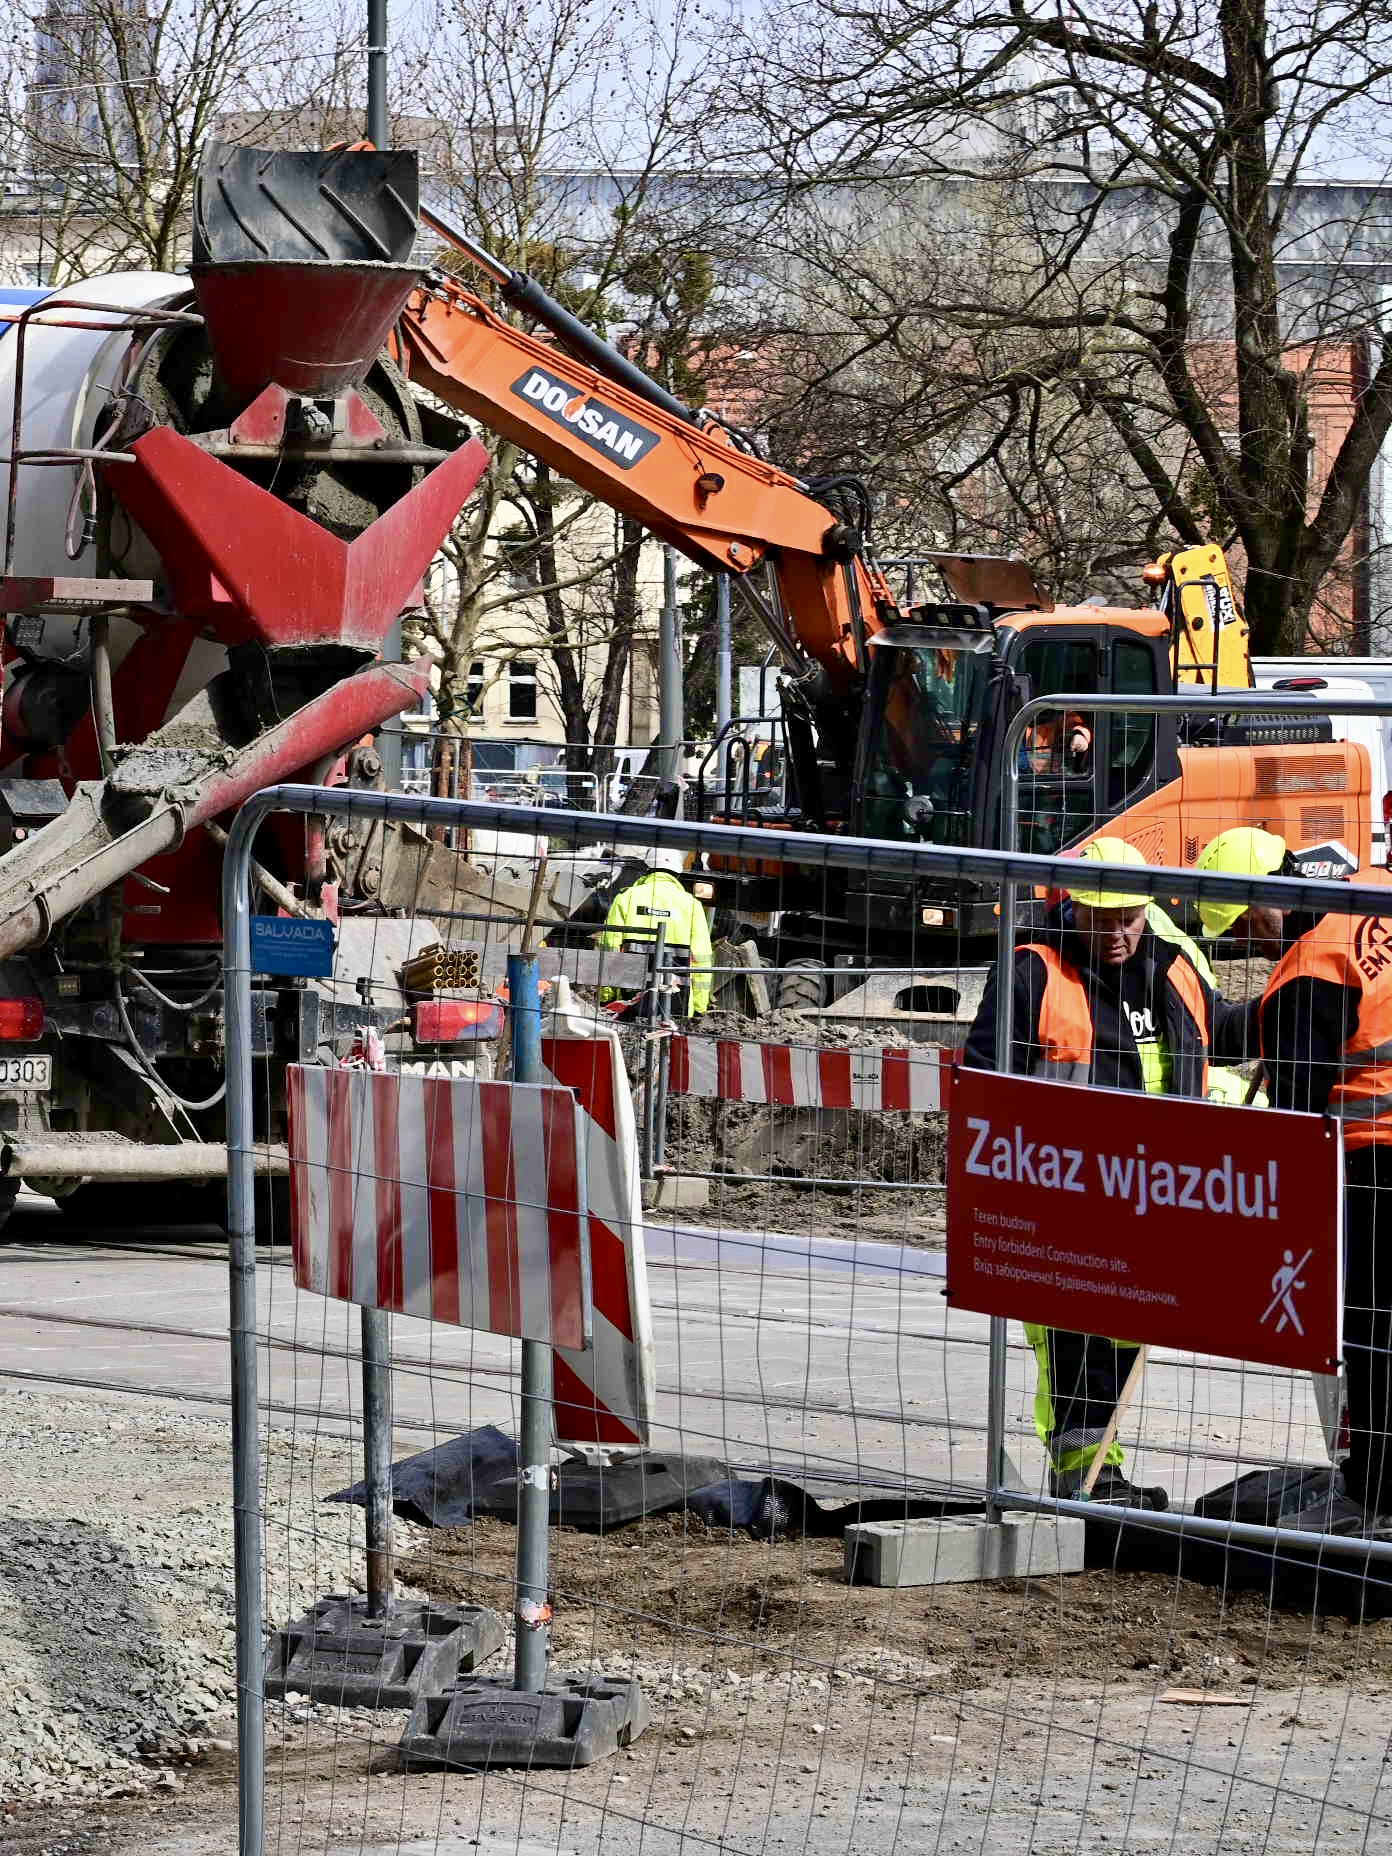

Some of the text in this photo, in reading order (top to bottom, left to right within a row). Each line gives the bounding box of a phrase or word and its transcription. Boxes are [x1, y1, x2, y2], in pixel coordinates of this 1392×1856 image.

[522, 372, 644, 460] DOOSAN
[400, 1060, 475, 1078] MAN
[965, 1116, 1279, 1220] Zakaz wjazdu!
[973, 1207, 998, 1225] Teren
[973, 1232, 997, 1253] Entry
[1047, 1245, 1108, 1268] Construction
